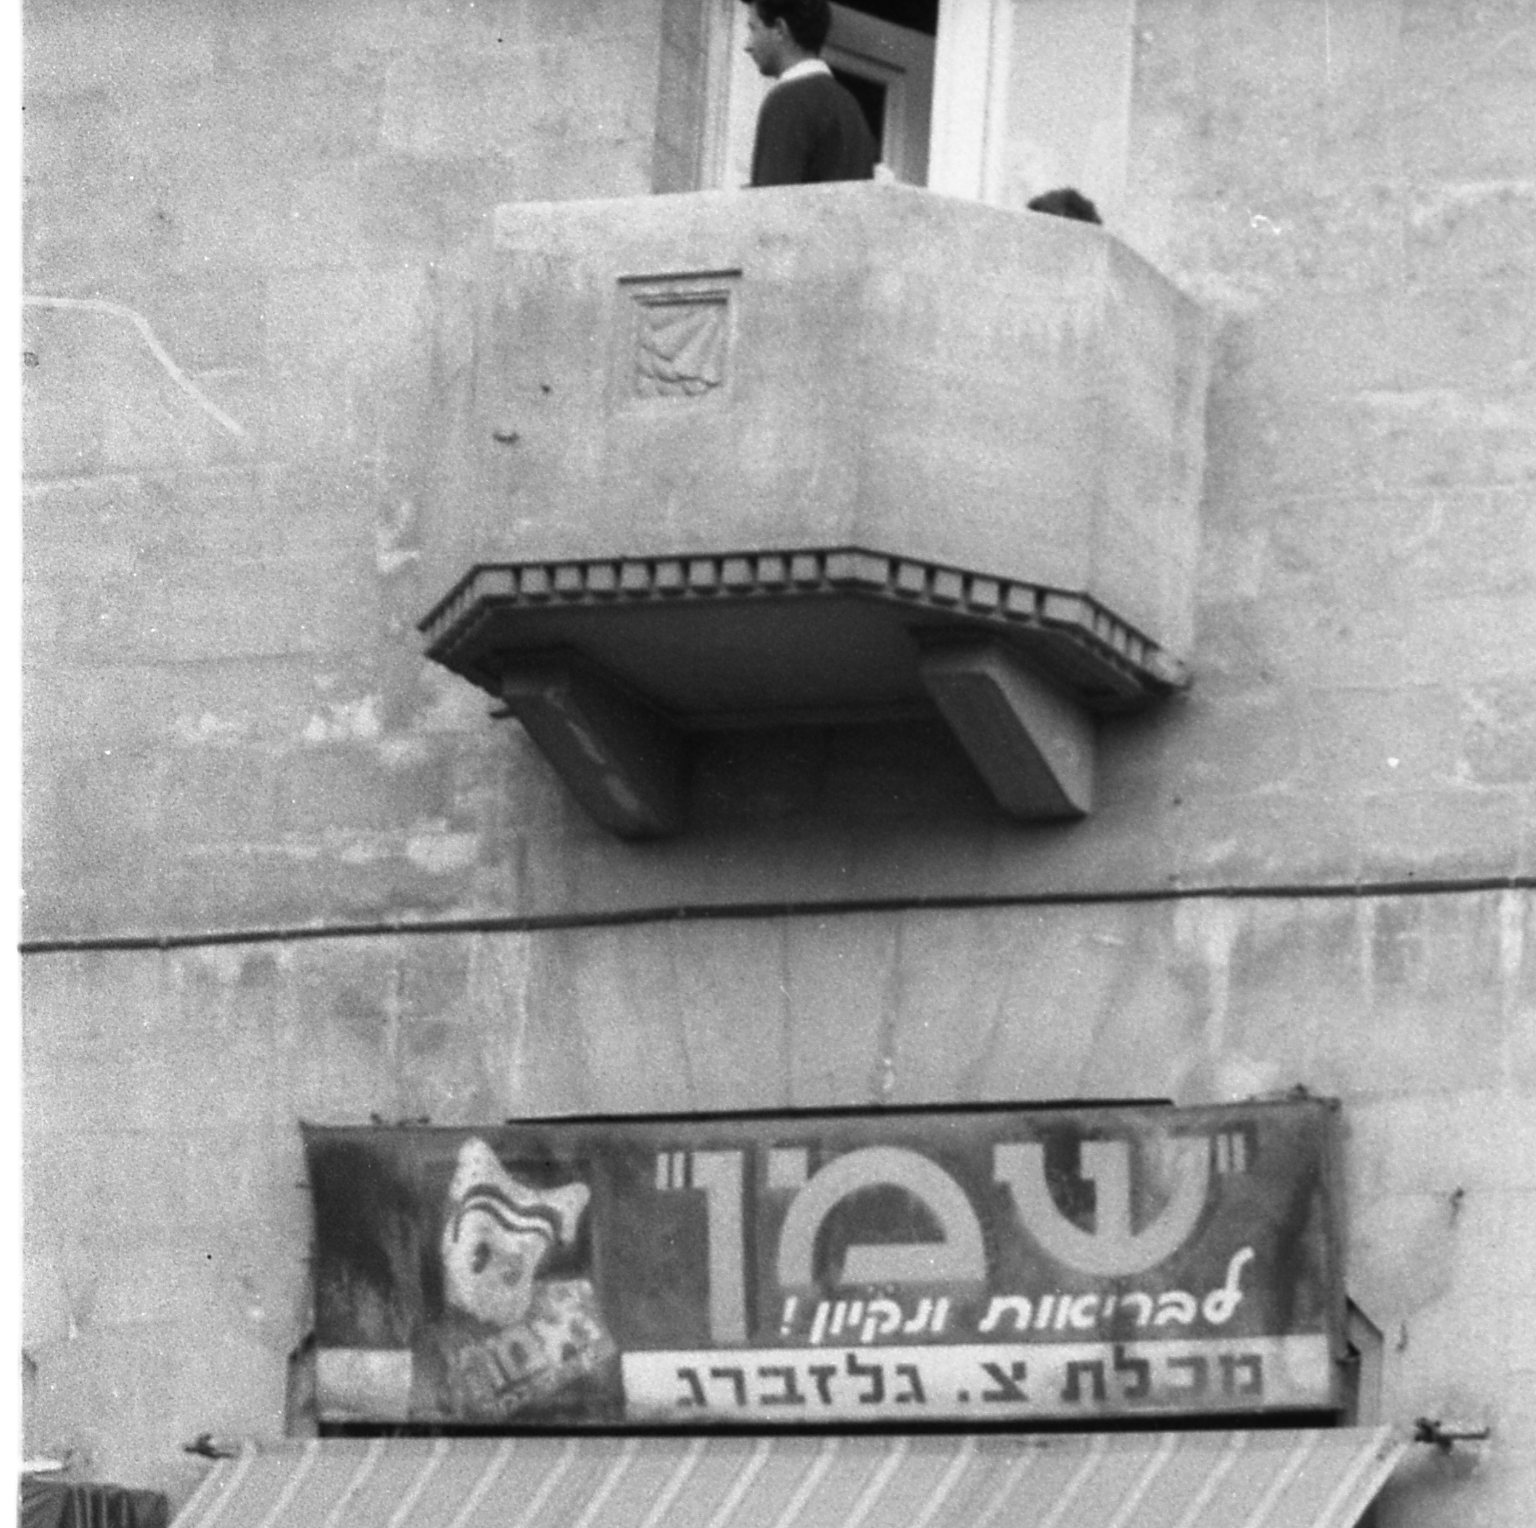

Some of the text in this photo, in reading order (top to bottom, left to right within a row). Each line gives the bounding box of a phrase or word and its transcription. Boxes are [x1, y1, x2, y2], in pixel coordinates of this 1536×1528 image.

[979, 1246, 1254, 1331] לבריאות
[678, 1353, 926, 1406] גלזברג
[1061, 1346, 1264, 1402] מכלת
